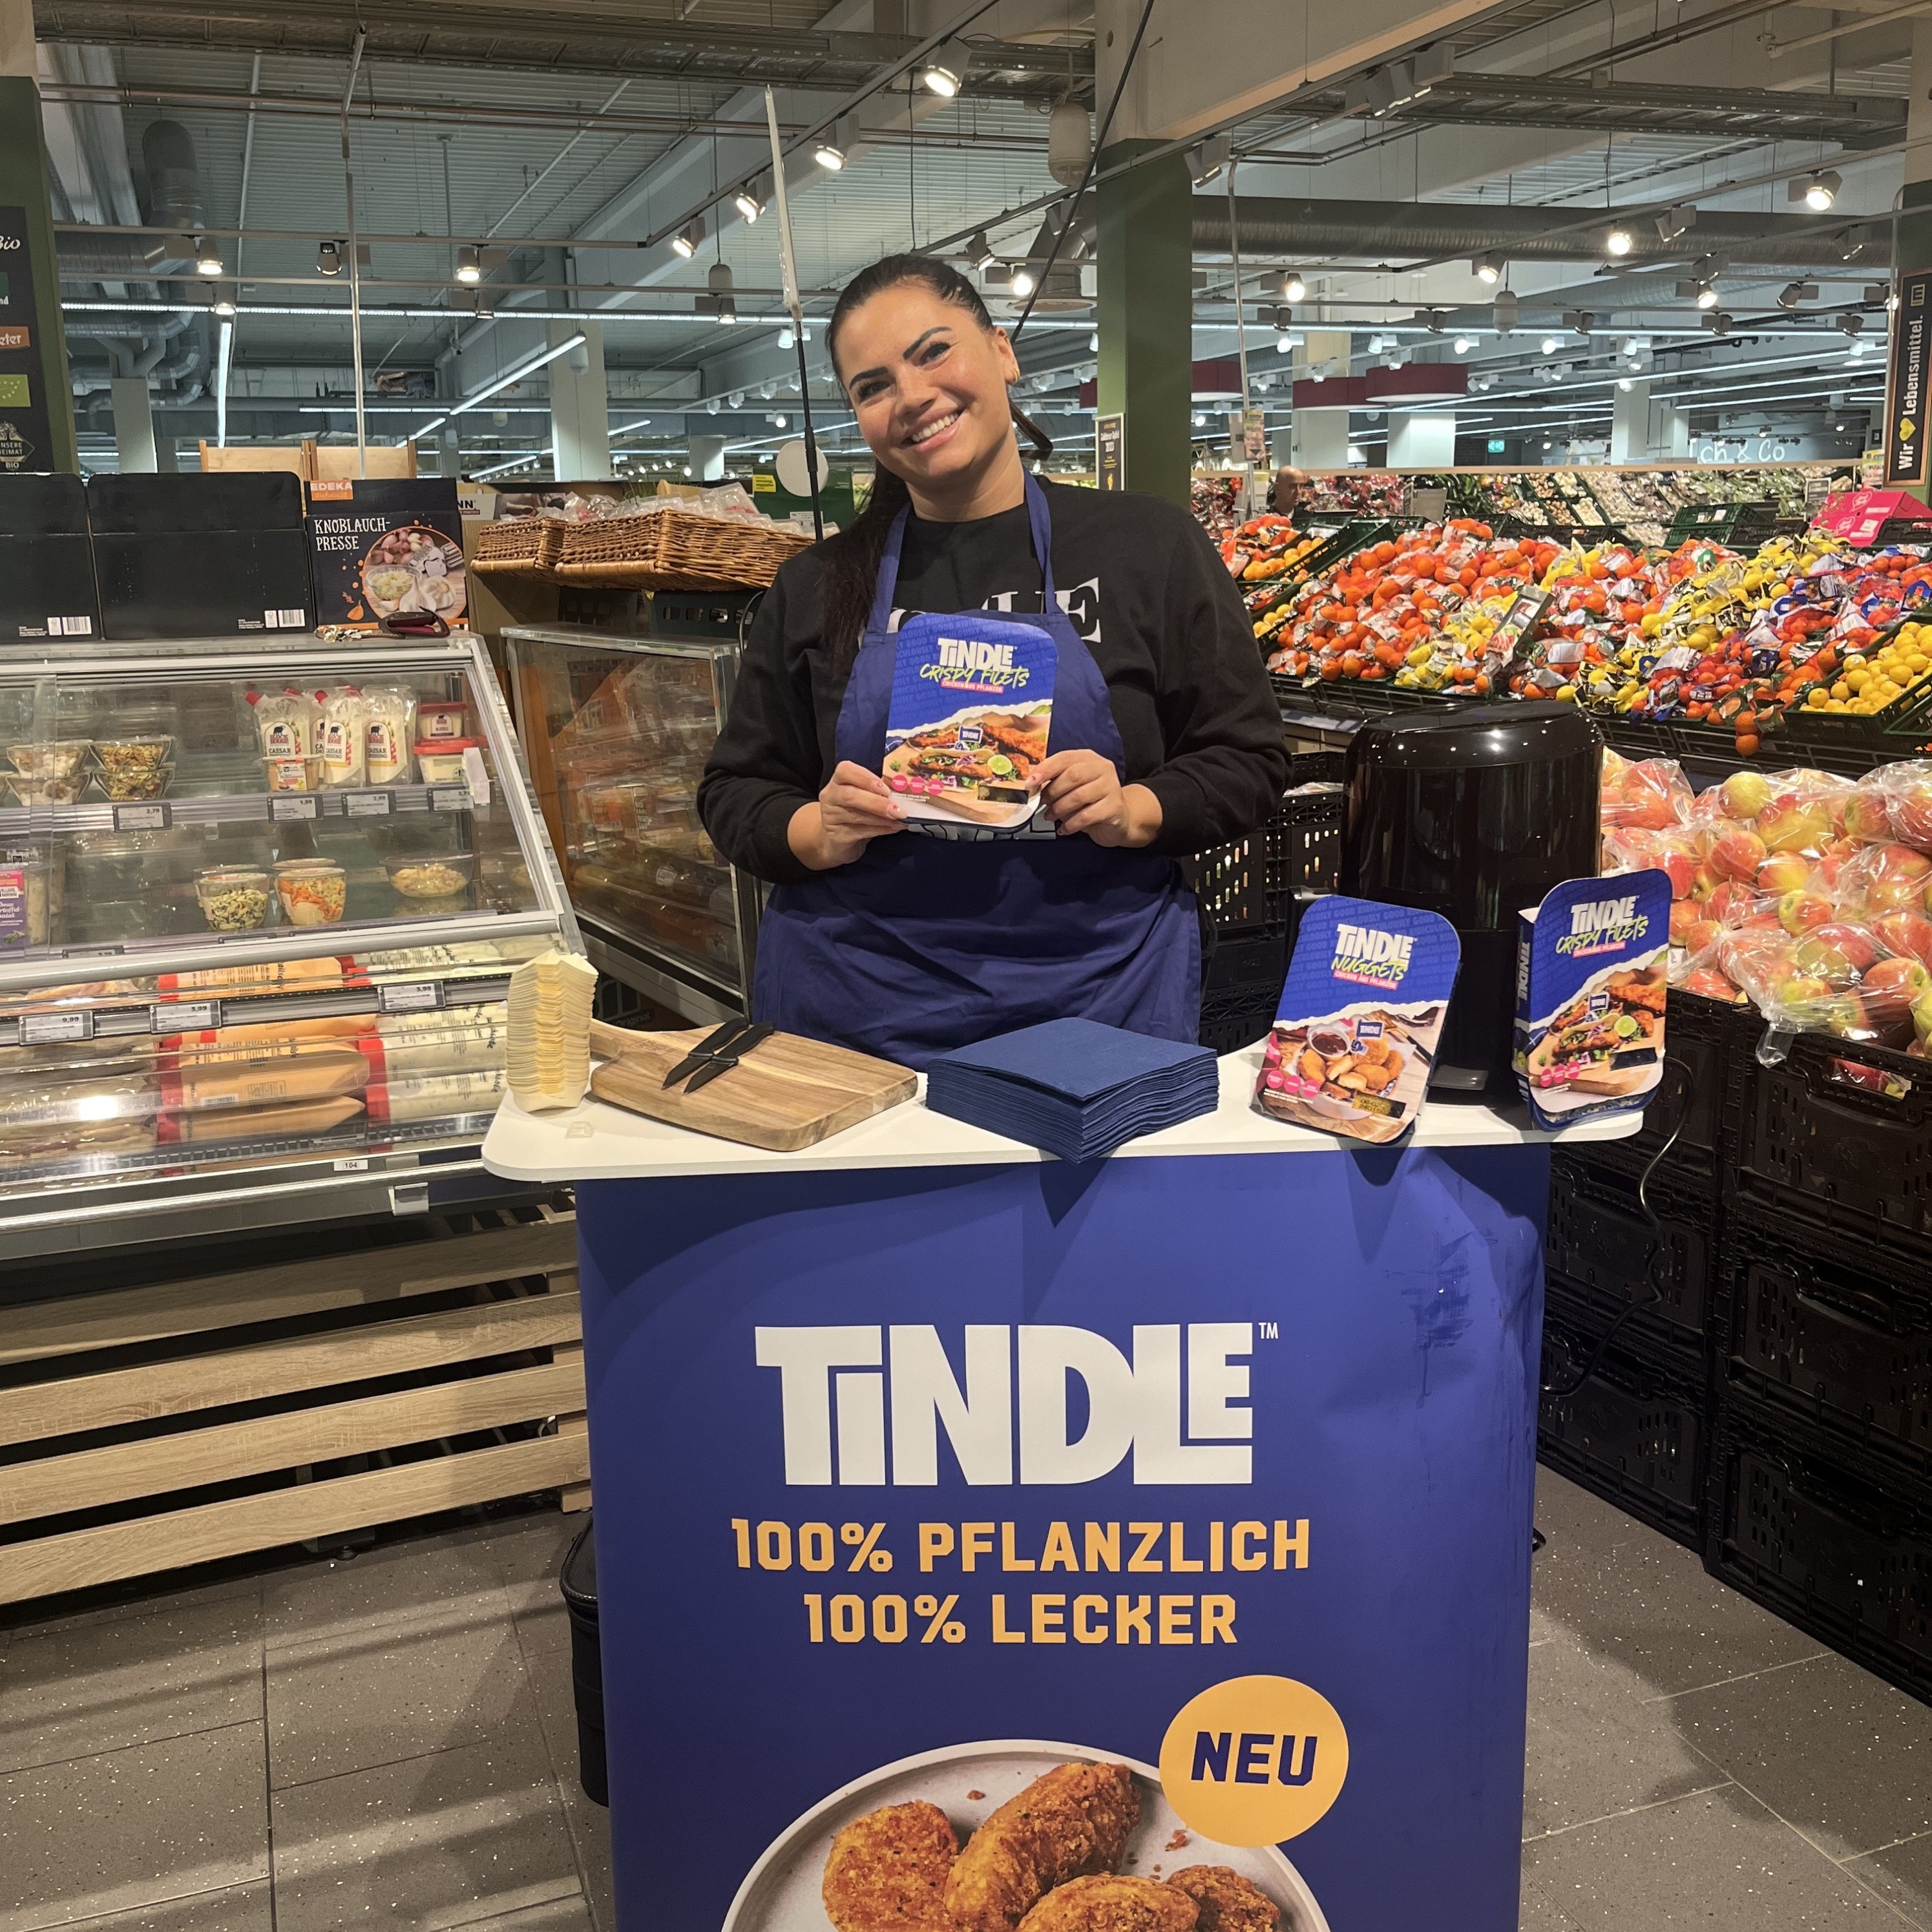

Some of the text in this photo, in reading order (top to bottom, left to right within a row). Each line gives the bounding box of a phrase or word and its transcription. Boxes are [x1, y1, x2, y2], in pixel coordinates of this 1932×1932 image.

[1898, 315, 1924, 470] Wir Lebensmittel.
[1758, 439, 1785, 462] Co
[311, 482, 353, 491] EDEKA
[313, 518, 391, 535] KNOBLAUCH-
[315, 535, 360, 551] PRESSE
[919, 663, 976, 684] CRISPY
[976, 684, 1003, 693] PFLANZEN
[1331, 956, 1409, 982] NUGGETS
[731, 1517, 1310, 1573] 100% PFLANZLICH
[804, 1593, 1238, 1644] 100% LECKER
[1191, 1731, 1318, 1787] NEU
